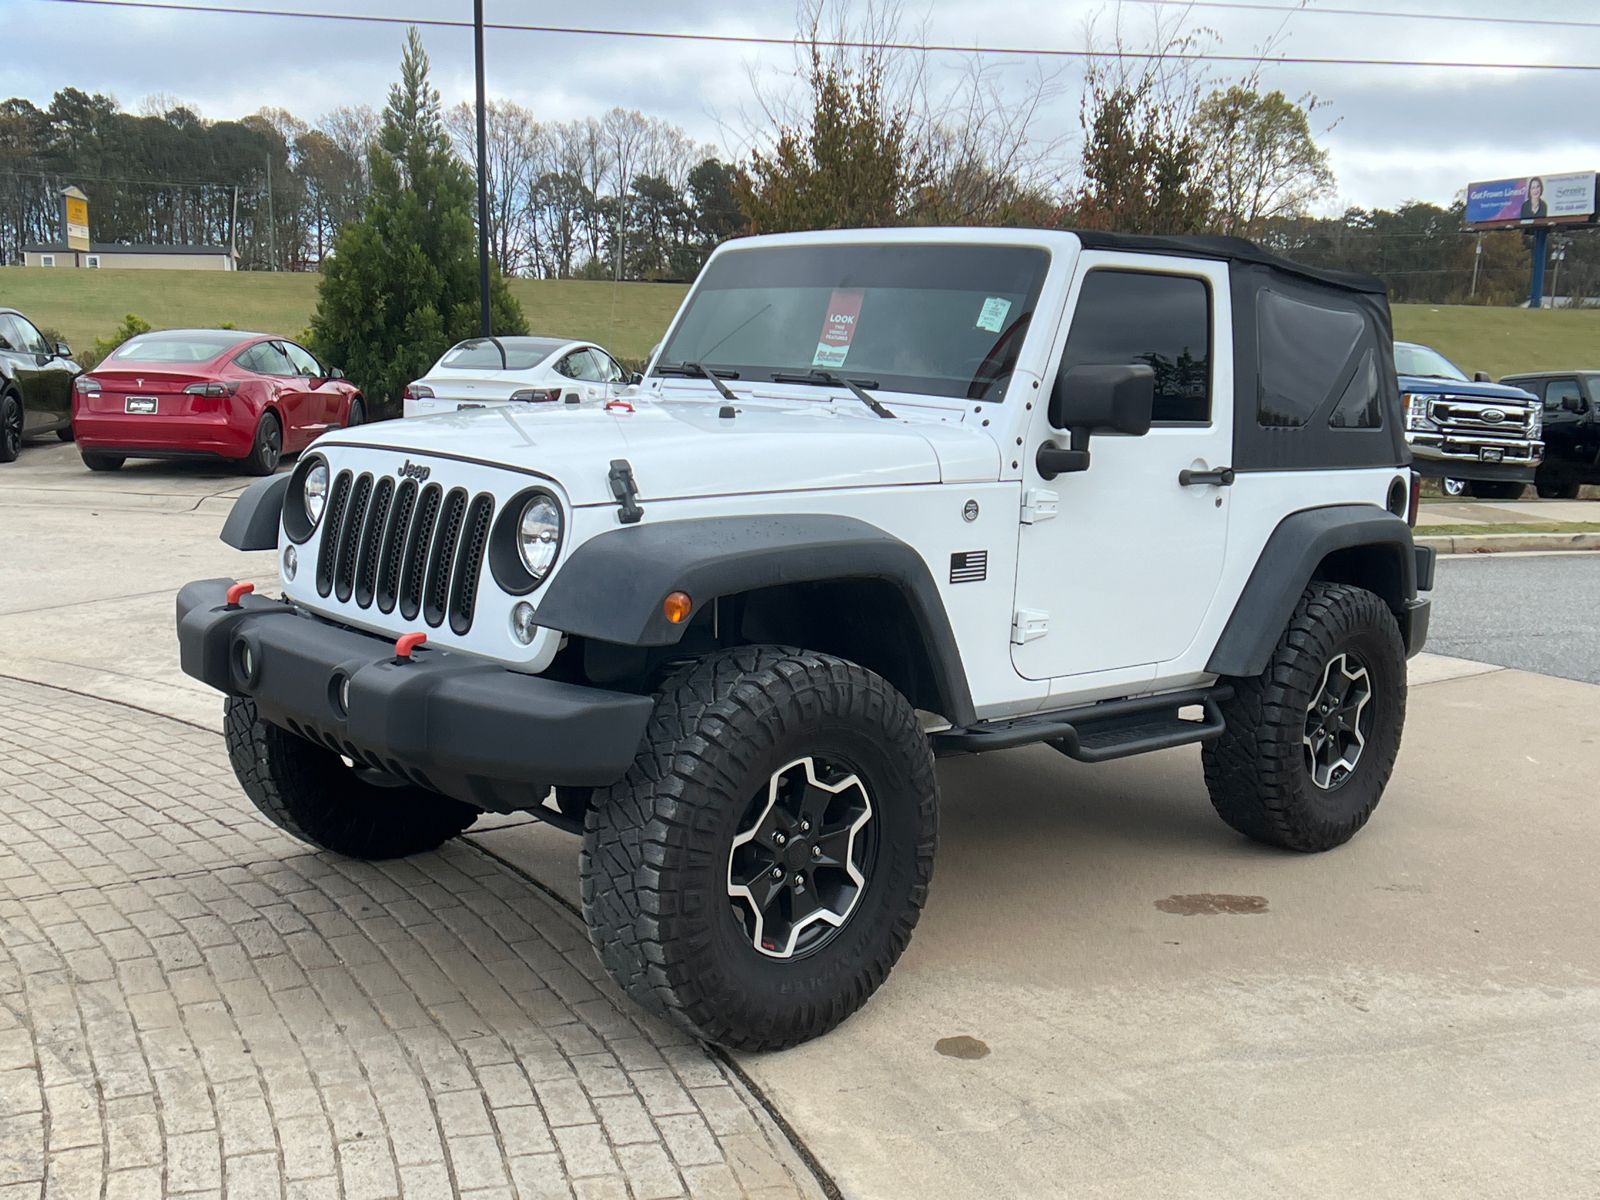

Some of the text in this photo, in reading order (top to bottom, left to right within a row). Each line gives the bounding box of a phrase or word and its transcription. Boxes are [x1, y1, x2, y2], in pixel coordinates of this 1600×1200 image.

[1483, 190, 1504, 199] Frown
[1504, 187, 1526, 197] Lines?
[830, 314, 854, 324] LOOK
[397, 459, 431, 483] Jeep
